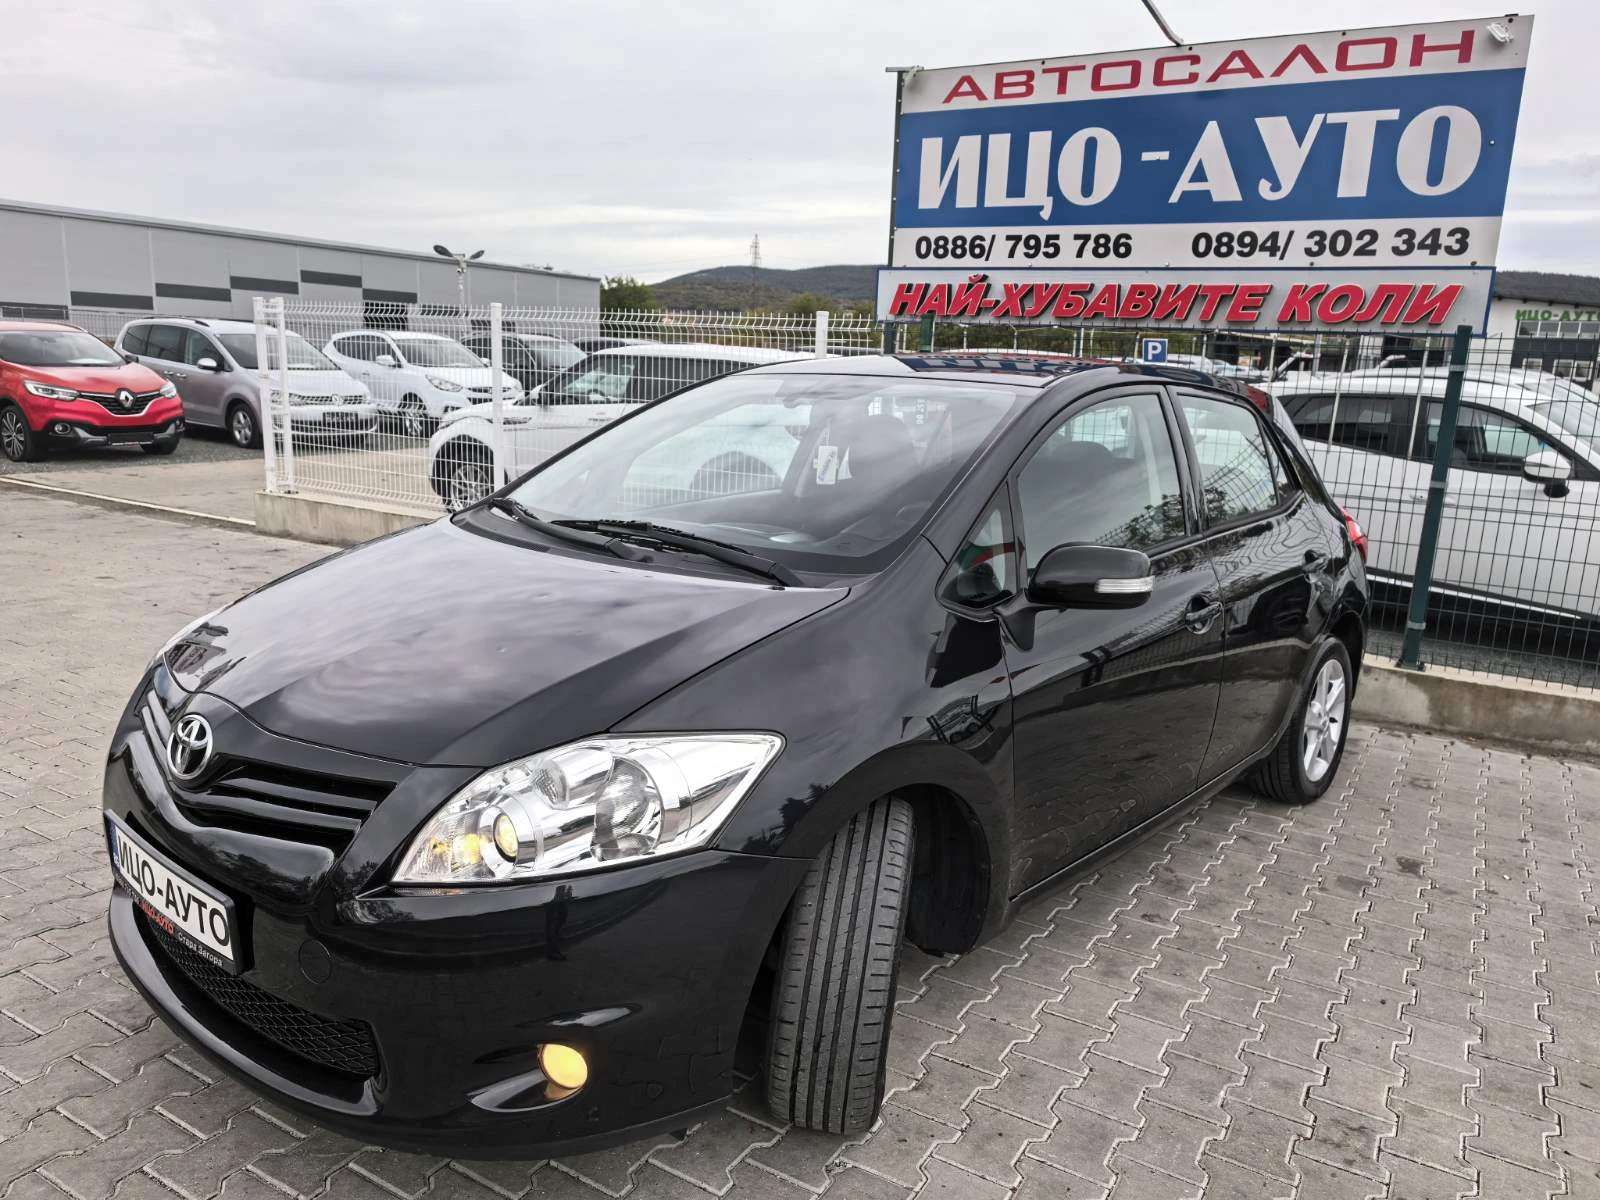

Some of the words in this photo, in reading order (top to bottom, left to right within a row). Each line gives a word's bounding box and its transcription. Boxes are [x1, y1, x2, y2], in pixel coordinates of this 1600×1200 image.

[942, 30, 1475, 104] АВТОСАЛОН
[915, 235, 996, 261] 0886/
[1005, 234, 1060, 259] 795
[1073, 233, 1133, 259] 786
[1192, 230, 1295, 260] 0894/
[1304, 229, 1379, 257] 302
[1391, 227, 1470, 256] 343
[888, 273, 1272, 322] НАЙ-ХУБАВИТЕ
[1276, 283, 1465, 325] КОЛИ
[1515, 309, 1600, 321] ИЦО-АУТ
[1147, 341, 1162, 361] P
[117, 834, 231, 947] ИЦО-АУТО
